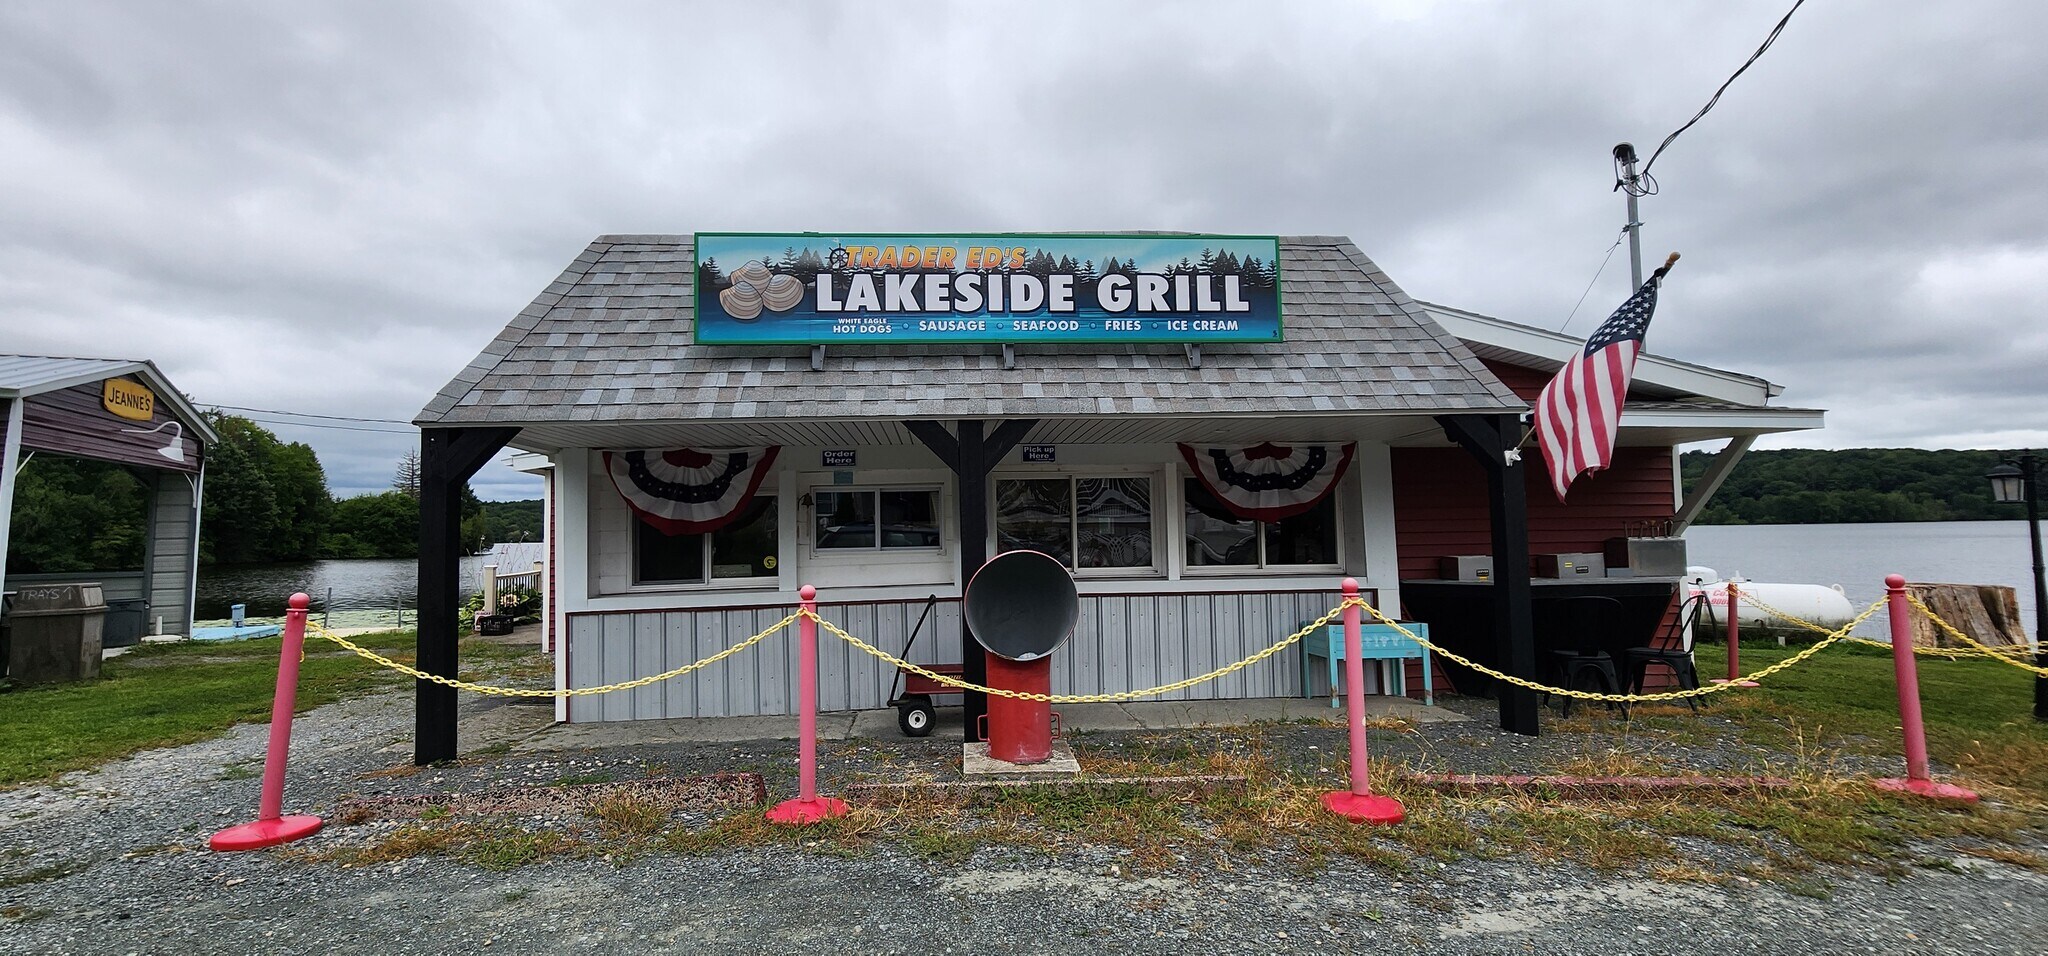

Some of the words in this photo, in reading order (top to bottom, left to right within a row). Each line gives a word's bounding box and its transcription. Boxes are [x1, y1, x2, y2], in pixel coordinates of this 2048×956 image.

[845, 245, 957, 269] TRADER
[966, 246, 1027, 269] ED'S
[815, 272, 1075, 313] LAKESIDE
[1097, 272, 1250, 313] GRILL
[833, 325, 856, 333] HOT
[860, 325, 892, 333] DOGS
[919, 320, 986, 331] SAUSAGE
[1013, 320, 1080, 331] SEAFOOD
[1105, 320, 1142, 331] FRIES
[1167, 320, 1189, 331] ICE
[1193, 320, 1239, 331] CREAM
[108, 387, 151, 411] JEANNE'S
[20, 588, 60, 600] TRAYS
